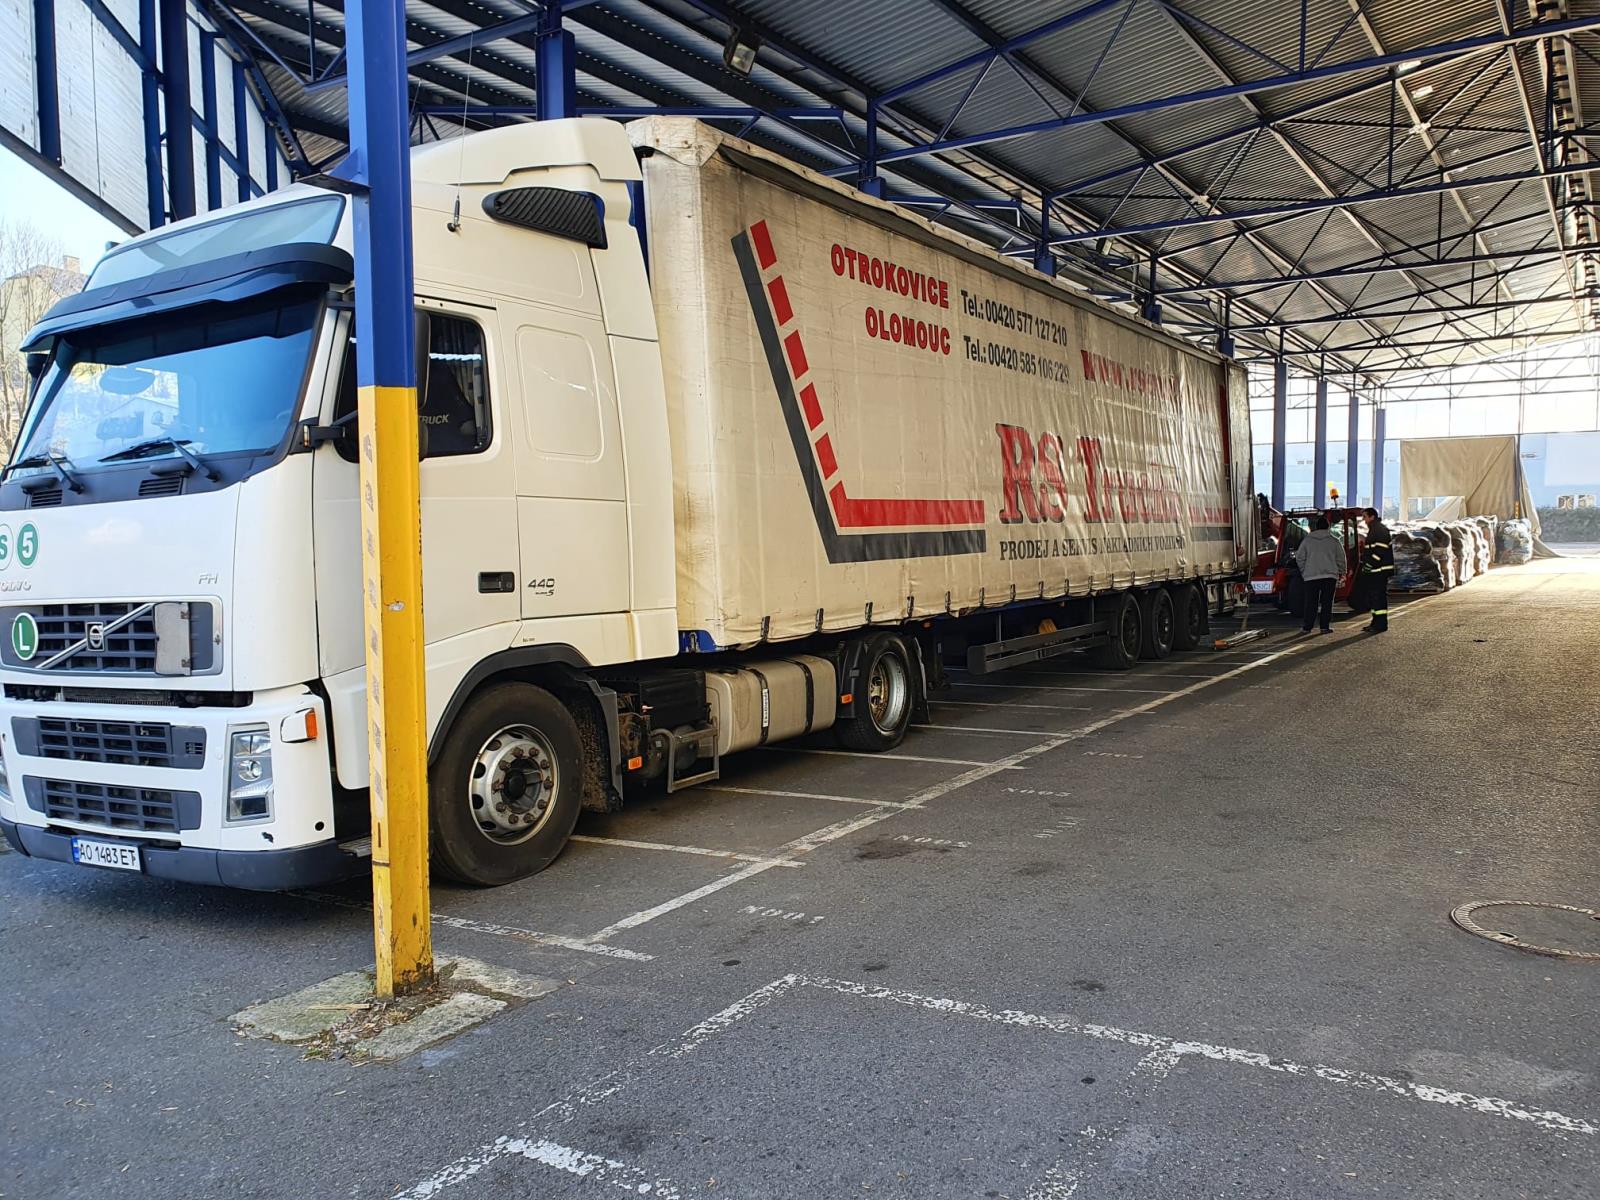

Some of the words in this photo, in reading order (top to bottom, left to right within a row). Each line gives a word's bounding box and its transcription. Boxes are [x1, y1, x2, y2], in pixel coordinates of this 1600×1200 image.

[831, 243, 949, 309] OTROKOVICE
[961, 289, 984, 320] Tel.:
[985, 298, 1015, 330] 00420
[1017, 310, 1033, 335] 577
[1035, 316, 1050, 341] 127
[1052, 322, 1067, 347] 210
[865, 306, 950, 355] OLOMOUC
[963, 335, 987, 364] Tel.:
[988, 342, 1018, 371] 00420
[1020, 351, 1036, 376] 585
[1038, 356, 1053, 380] 106
[1055, 361, 1070, 385] 229
[995, 423, 1068, 524] RS
[22, 531, 34, 558] 5
[1000, 539, 1049, 560] PRODEJ
[1052, 539, 1060, 557] A
[1062, 537, 1098, 557] SERVIS
[198, 574, 218, 584] FH
[527, 578, 555, 588] 440
[19, 622, 31, 651] L
